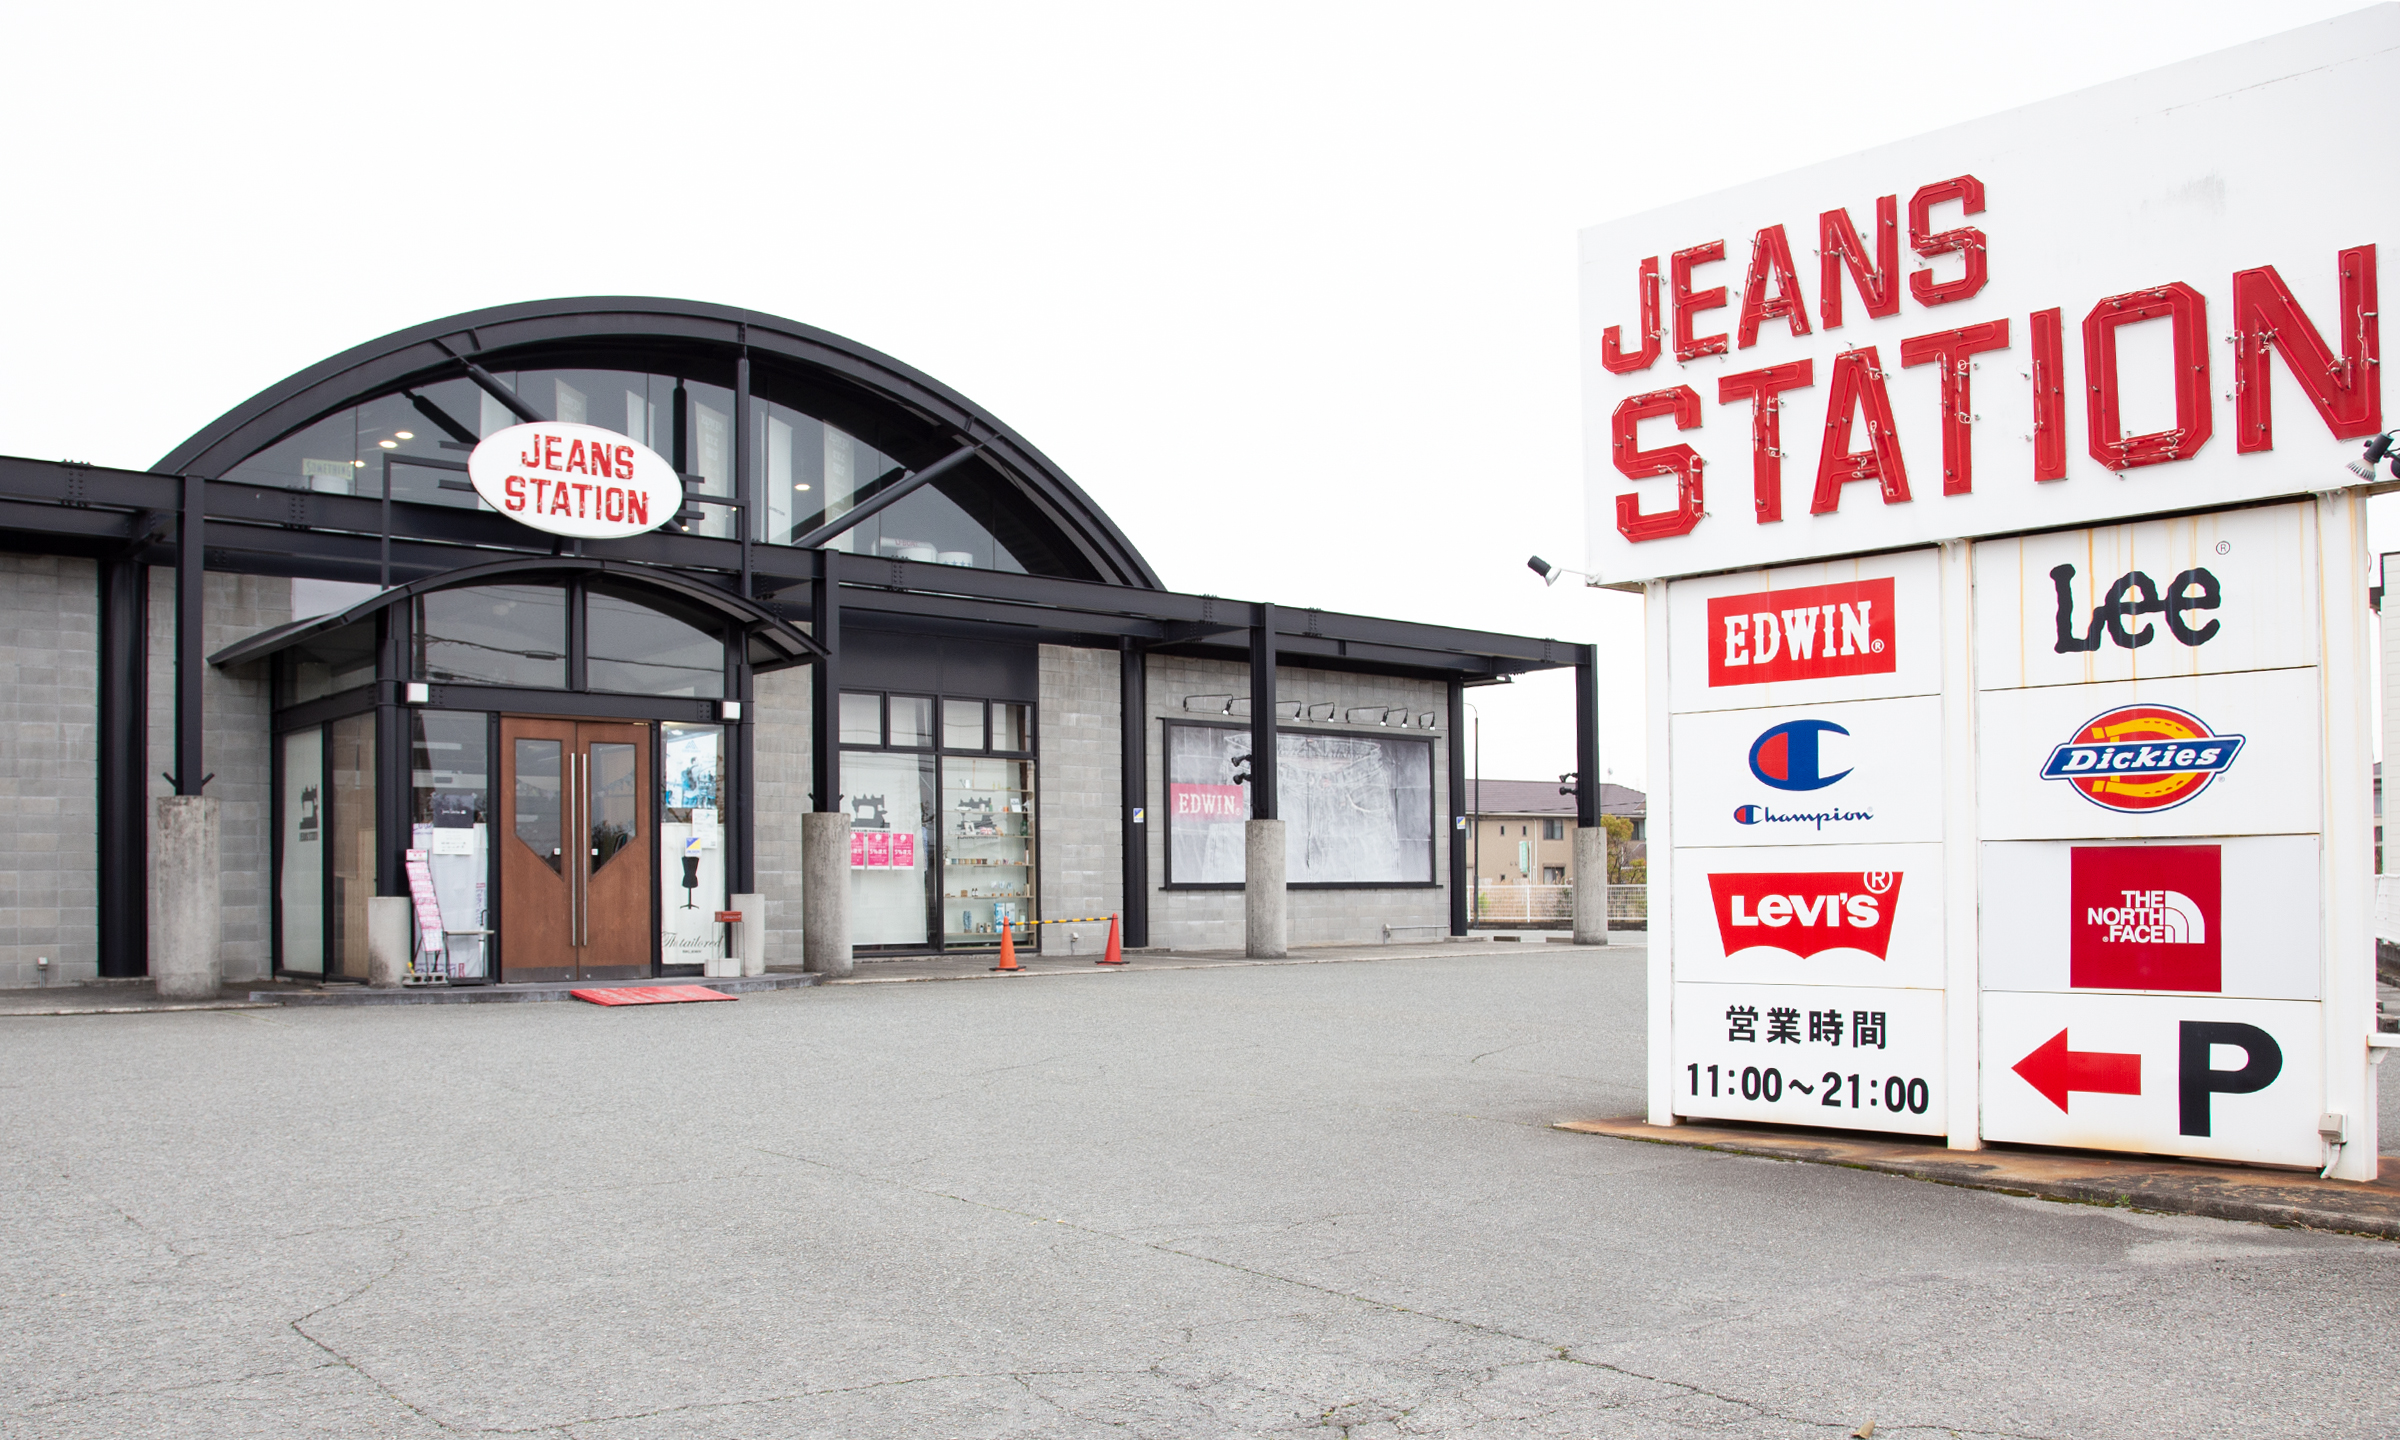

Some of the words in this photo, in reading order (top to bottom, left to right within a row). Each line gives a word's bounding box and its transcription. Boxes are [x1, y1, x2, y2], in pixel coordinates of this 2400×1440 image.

[1602, 174, 1988, 376] JEANS
[1611, 243, 2383, 544] STATION
[521, 433, 635, 480] JEANS
[504, 475, 649, 526] STATION
[2050, 563, 2221, 654] Lee
[1724, 600, 1873, 667] EDWIN
[2061, 745, 2222, 773] Dickies
[1179, 793, 1235, 815] EDWIN
[1733, 804, 1874, 831] Champion
[2087, 907, 2165, 926] NORTH
[2121, 890, 2164, 908] THE
[2109, 924, 2165, 943] FACE
[1725, 1005, 1887, 1050] 営業時間
[2179, 1020, 2283, 1138] P
